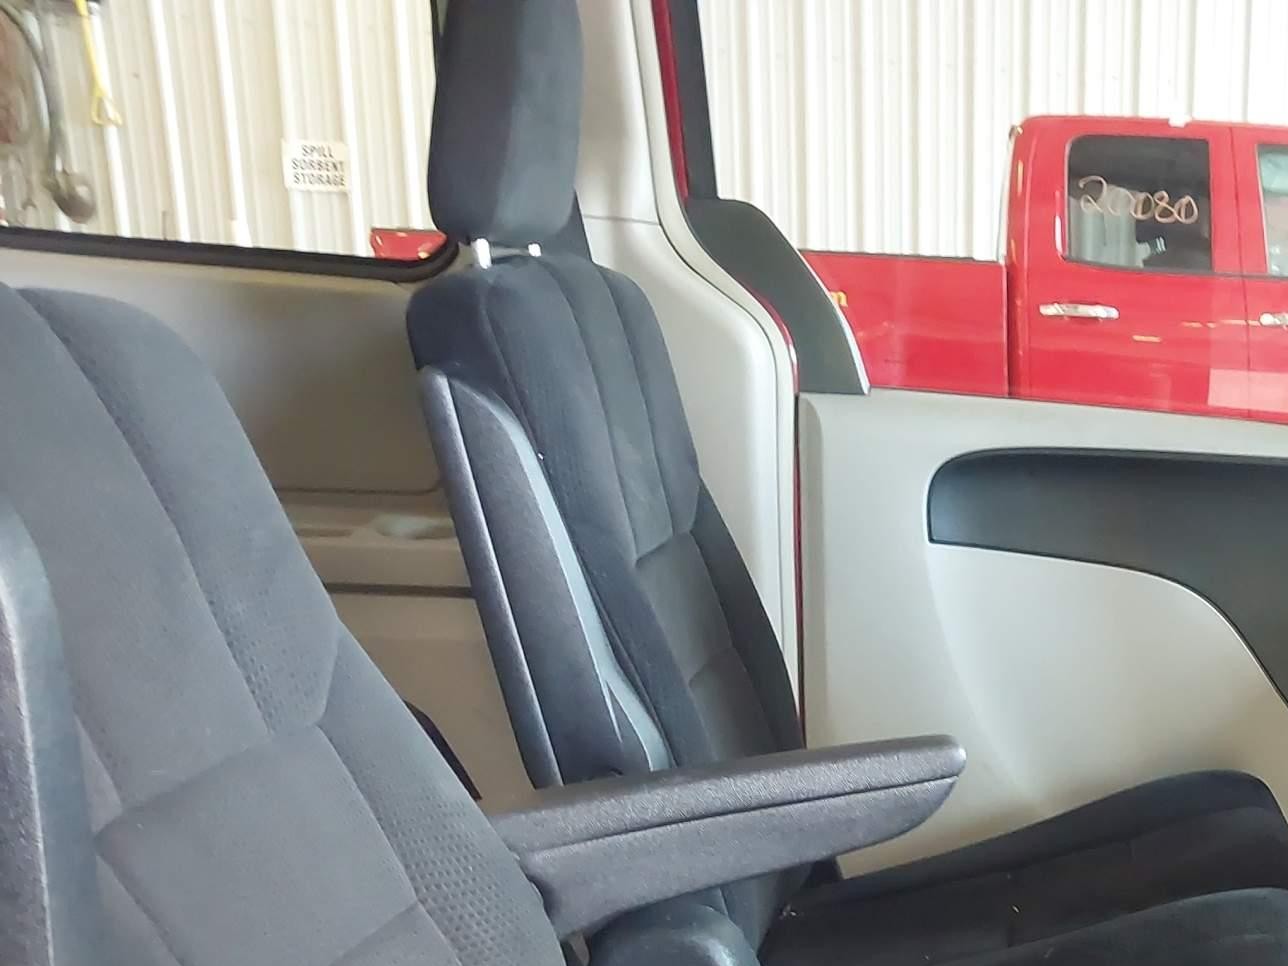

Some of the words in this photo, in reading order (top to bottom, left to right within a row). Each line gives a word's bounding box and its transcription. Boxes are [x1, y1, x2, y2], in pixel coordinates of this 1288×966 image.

[301, 144, 334, 159] SPILL
[291, 158, 345, 172] SORBENT
[293, 172, 345, 186] STORAGE
